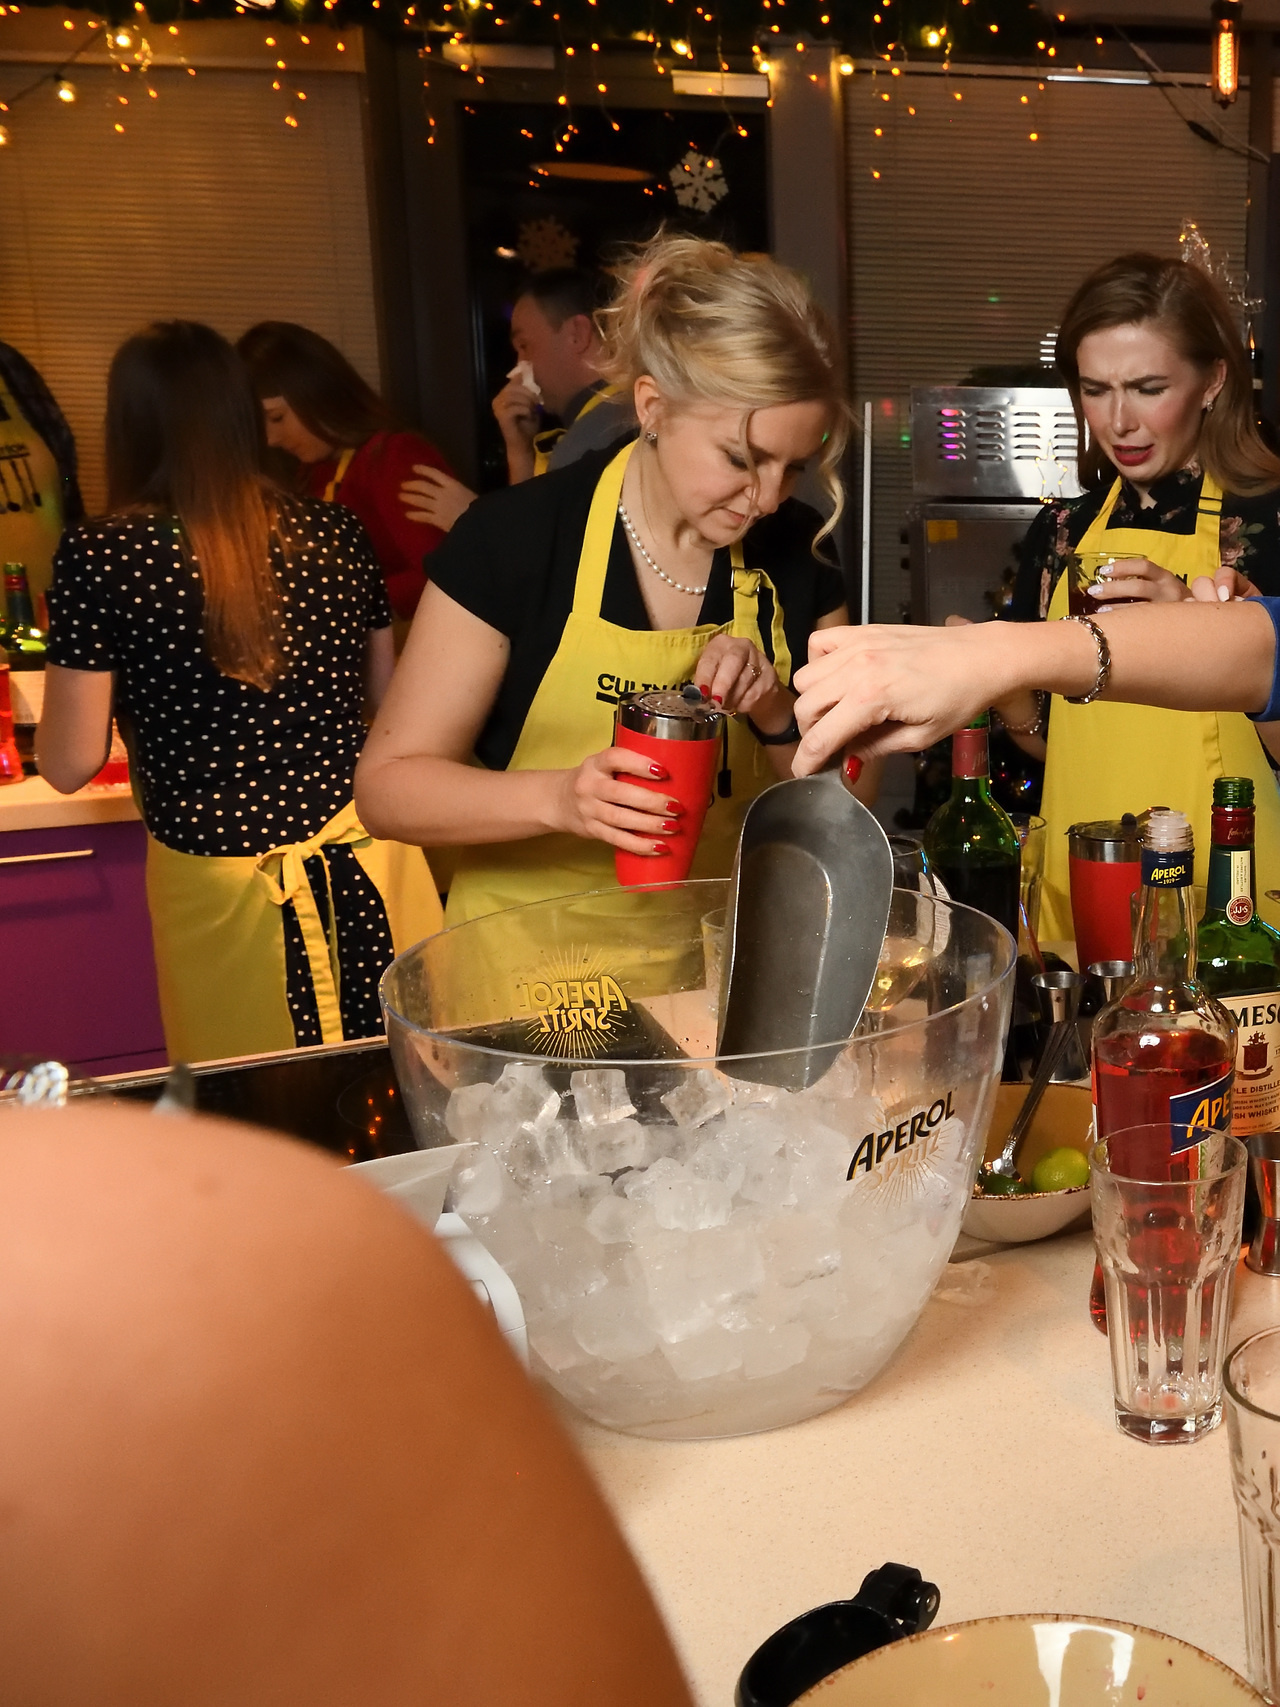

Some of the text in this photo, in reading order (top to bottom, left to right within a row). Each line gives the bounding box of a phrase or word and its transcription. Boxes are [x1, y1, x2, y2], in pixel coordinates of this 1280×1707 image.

[1151, 864, 1186, 881] APEROL
[1248, 1106, 1279, 1118] WHISKEY
[846, 1090, 956, 1181] APEROL
